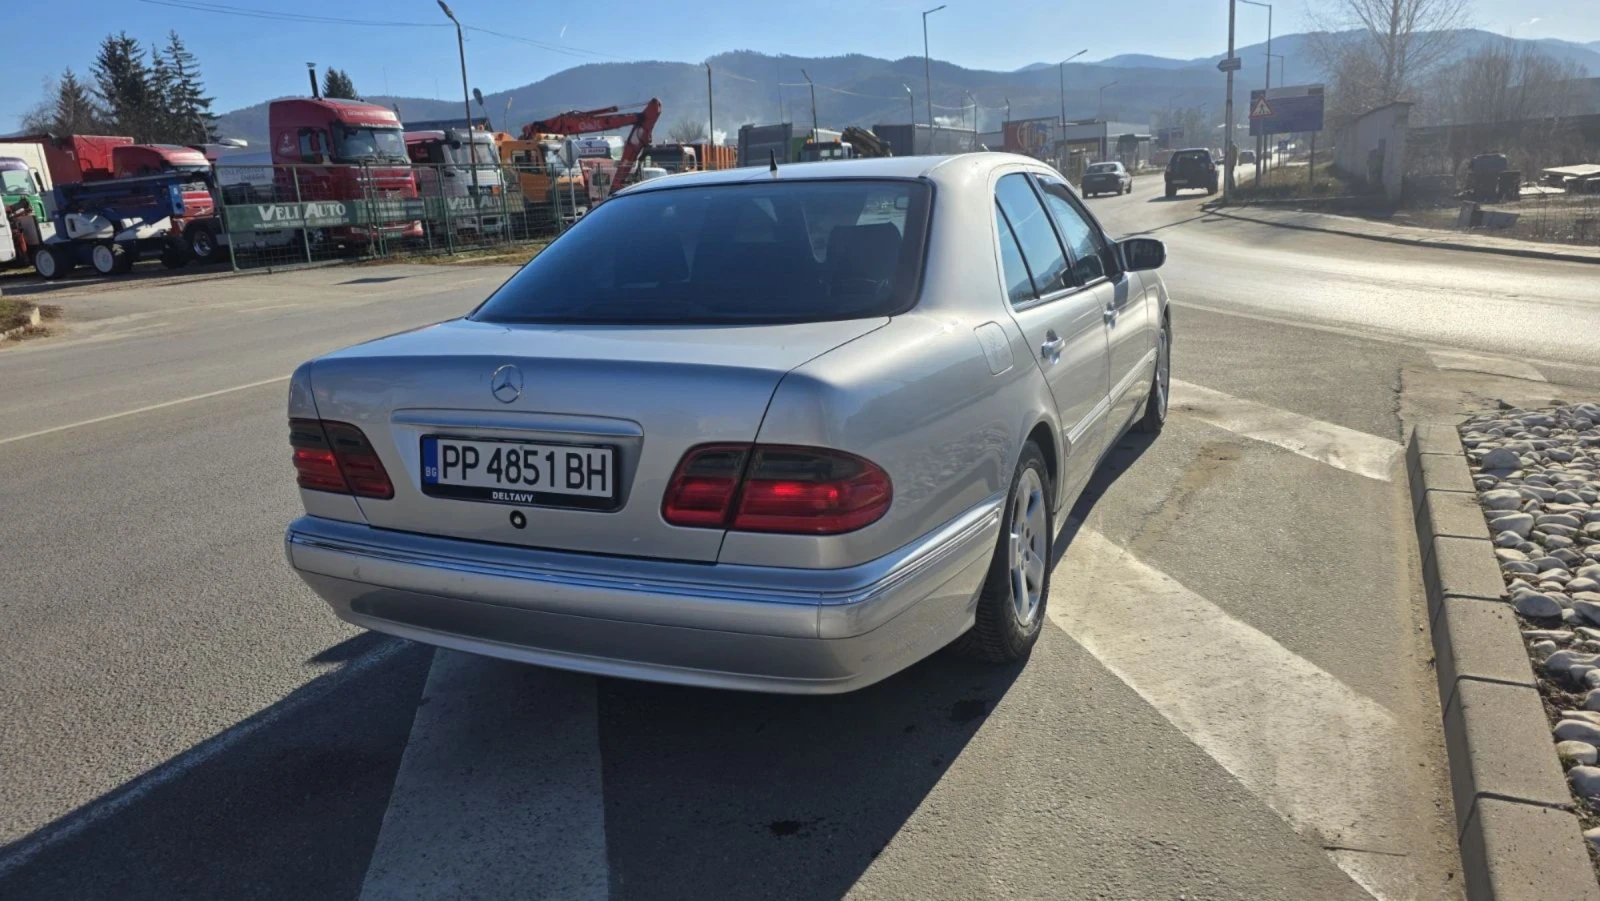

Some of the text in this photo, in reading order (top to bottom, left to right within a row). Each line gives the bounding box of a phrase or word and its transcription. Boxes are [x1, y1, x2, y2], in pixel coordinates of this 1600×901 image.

[258, 202, 346, 221] VELI AUTO
[425, 466, 437, 478] BG
[442, 445, 607, 492] PP 4851 BH
[492, 491, 534, 503] DELTAVV
